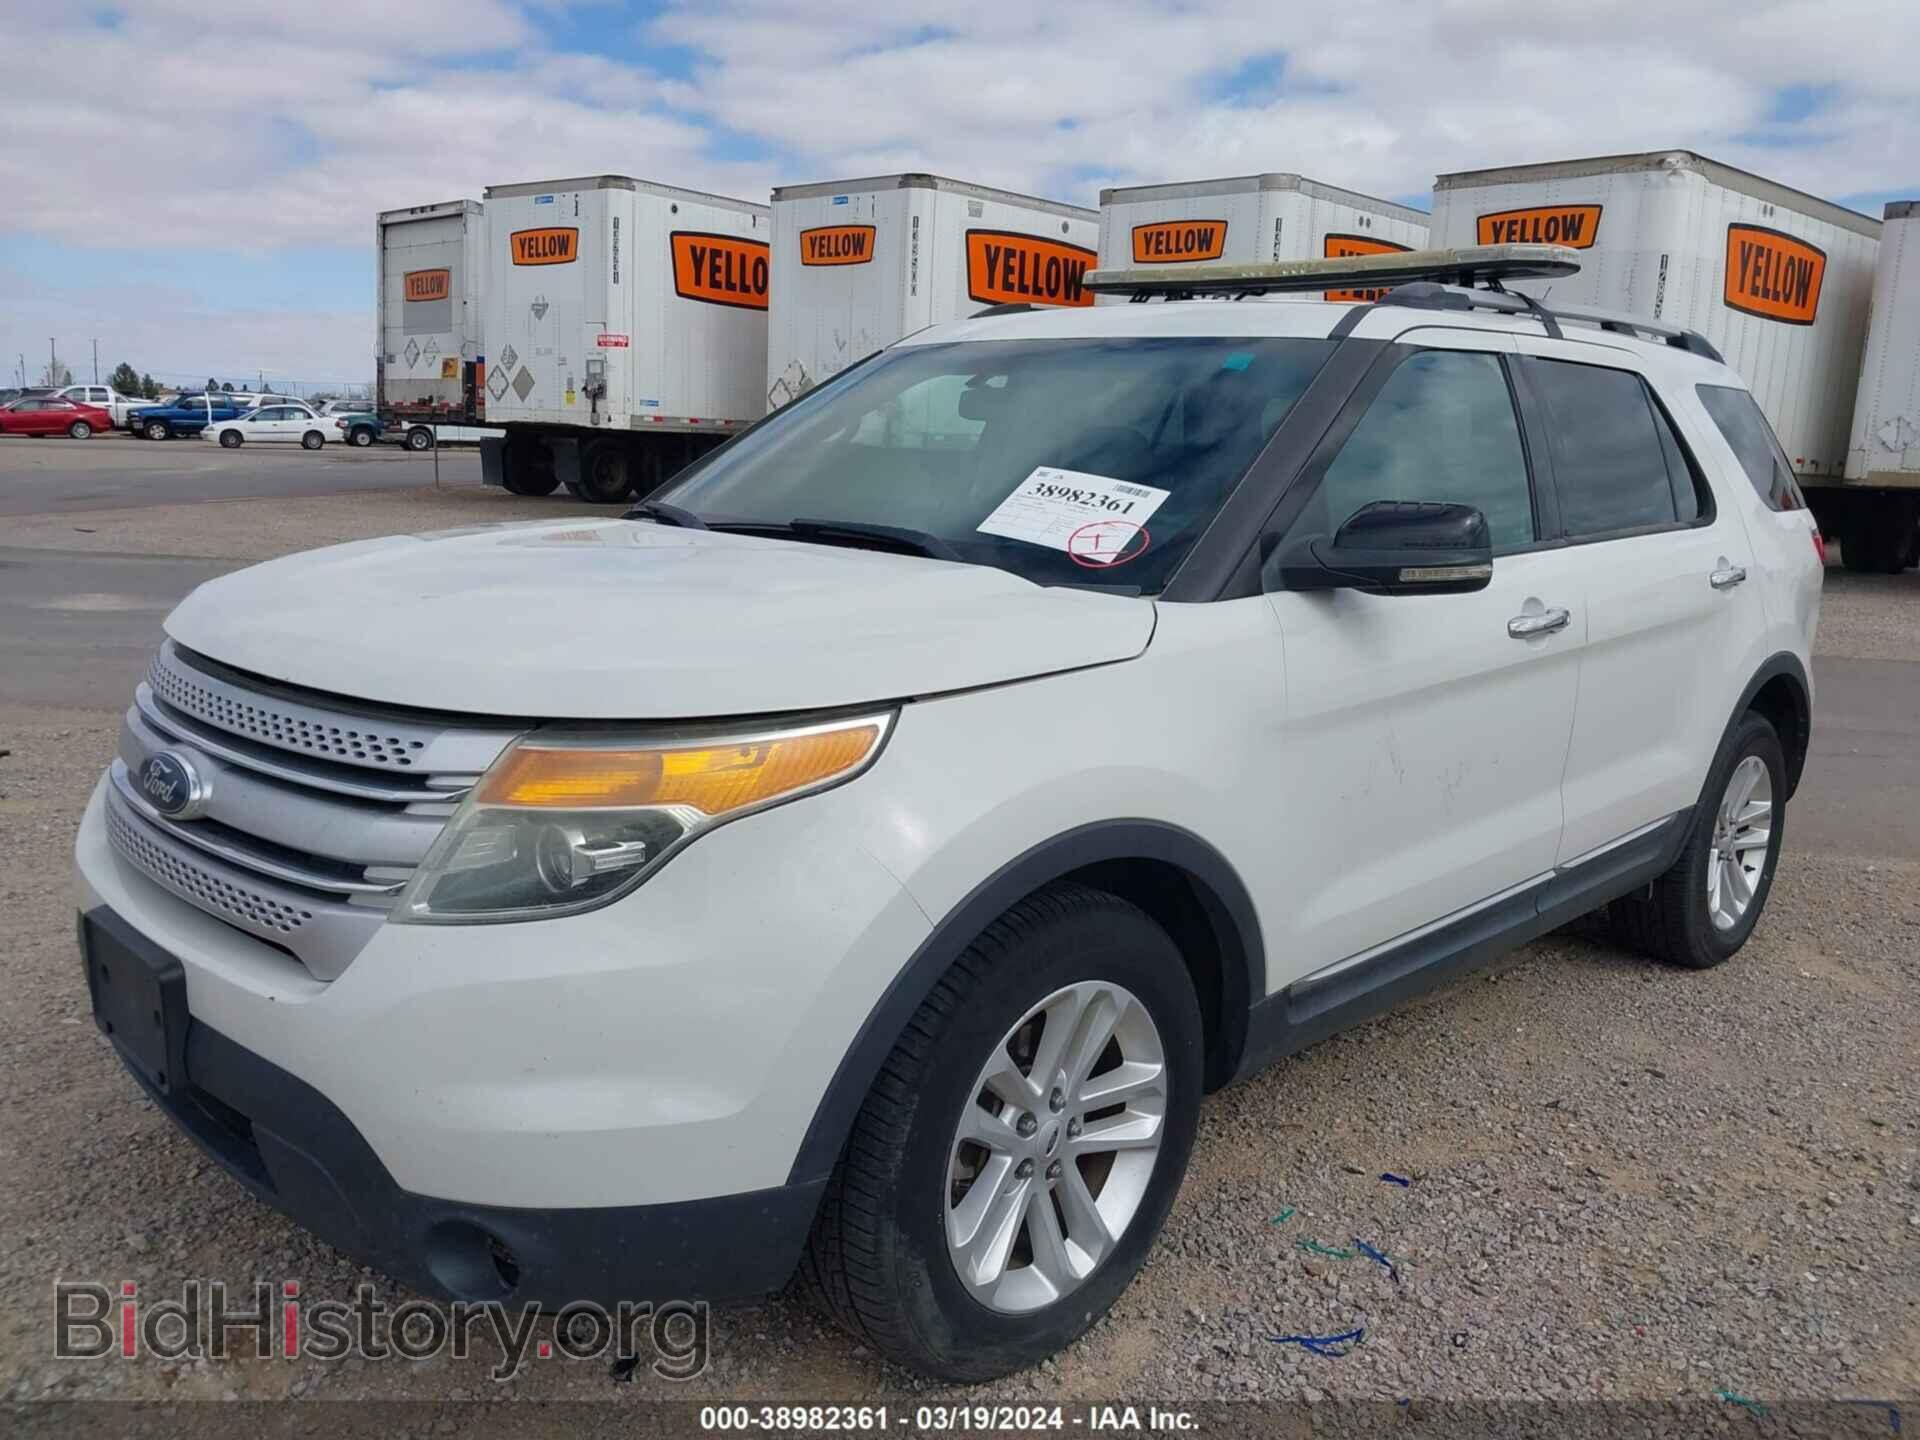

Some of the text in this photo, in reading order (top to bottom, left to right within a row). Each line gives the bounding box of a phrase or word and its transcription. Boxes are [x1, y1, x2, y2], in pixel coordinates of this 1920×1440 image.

[1143, 227, 1215, 255] YELLOW
[1491, 213, 1585, 244] YELLOW
[518, 234, 570, 258] YELLOW
[809, 232, 866, 258] YELLOW
[409, 274, 445, 297] YELLOW
[689, 244, 768, 296] YELLO
[984, 243, 1087, 302] YELLOW
[1738, 240, 1815, 309] YELLOW
[1027, 482, 1135, 515] 38982361
[143, 759, 179, 803] Ford
